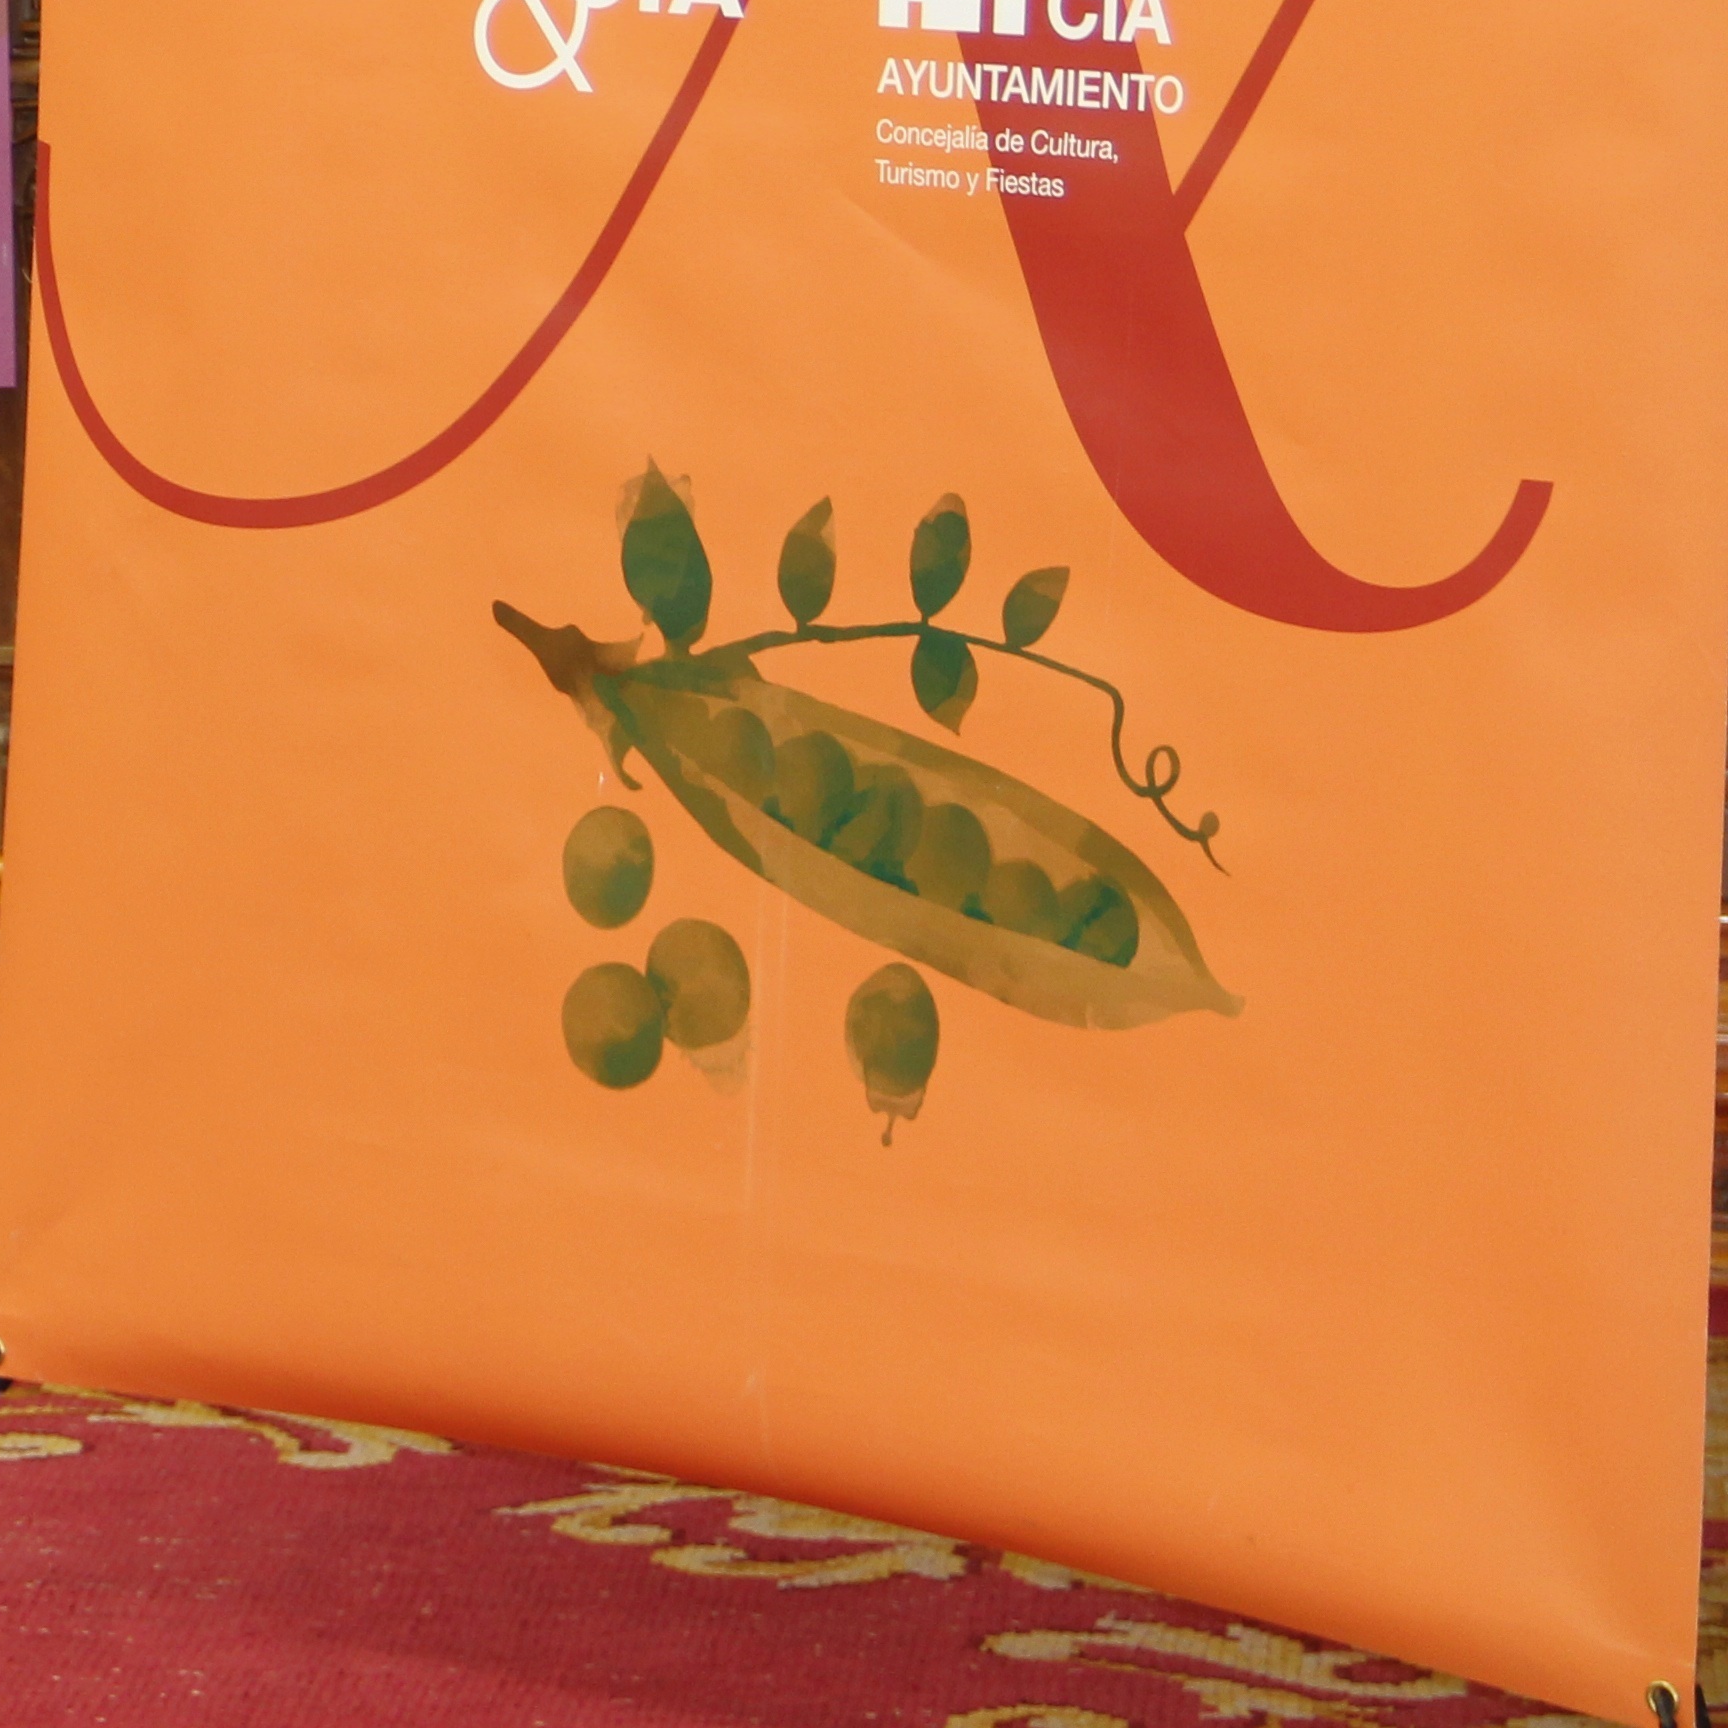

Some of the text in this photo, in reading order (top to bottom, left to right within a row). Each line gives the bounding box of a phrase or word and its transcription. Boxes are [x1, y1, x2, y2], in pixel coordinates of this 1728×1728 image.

[877, 57, 1184, 114] AYUNTAMIENTO
[877, 118, 1118, 162] Concejalía de Cultura,
[875, 159, 1065, 199] Turismo y Fiestas
